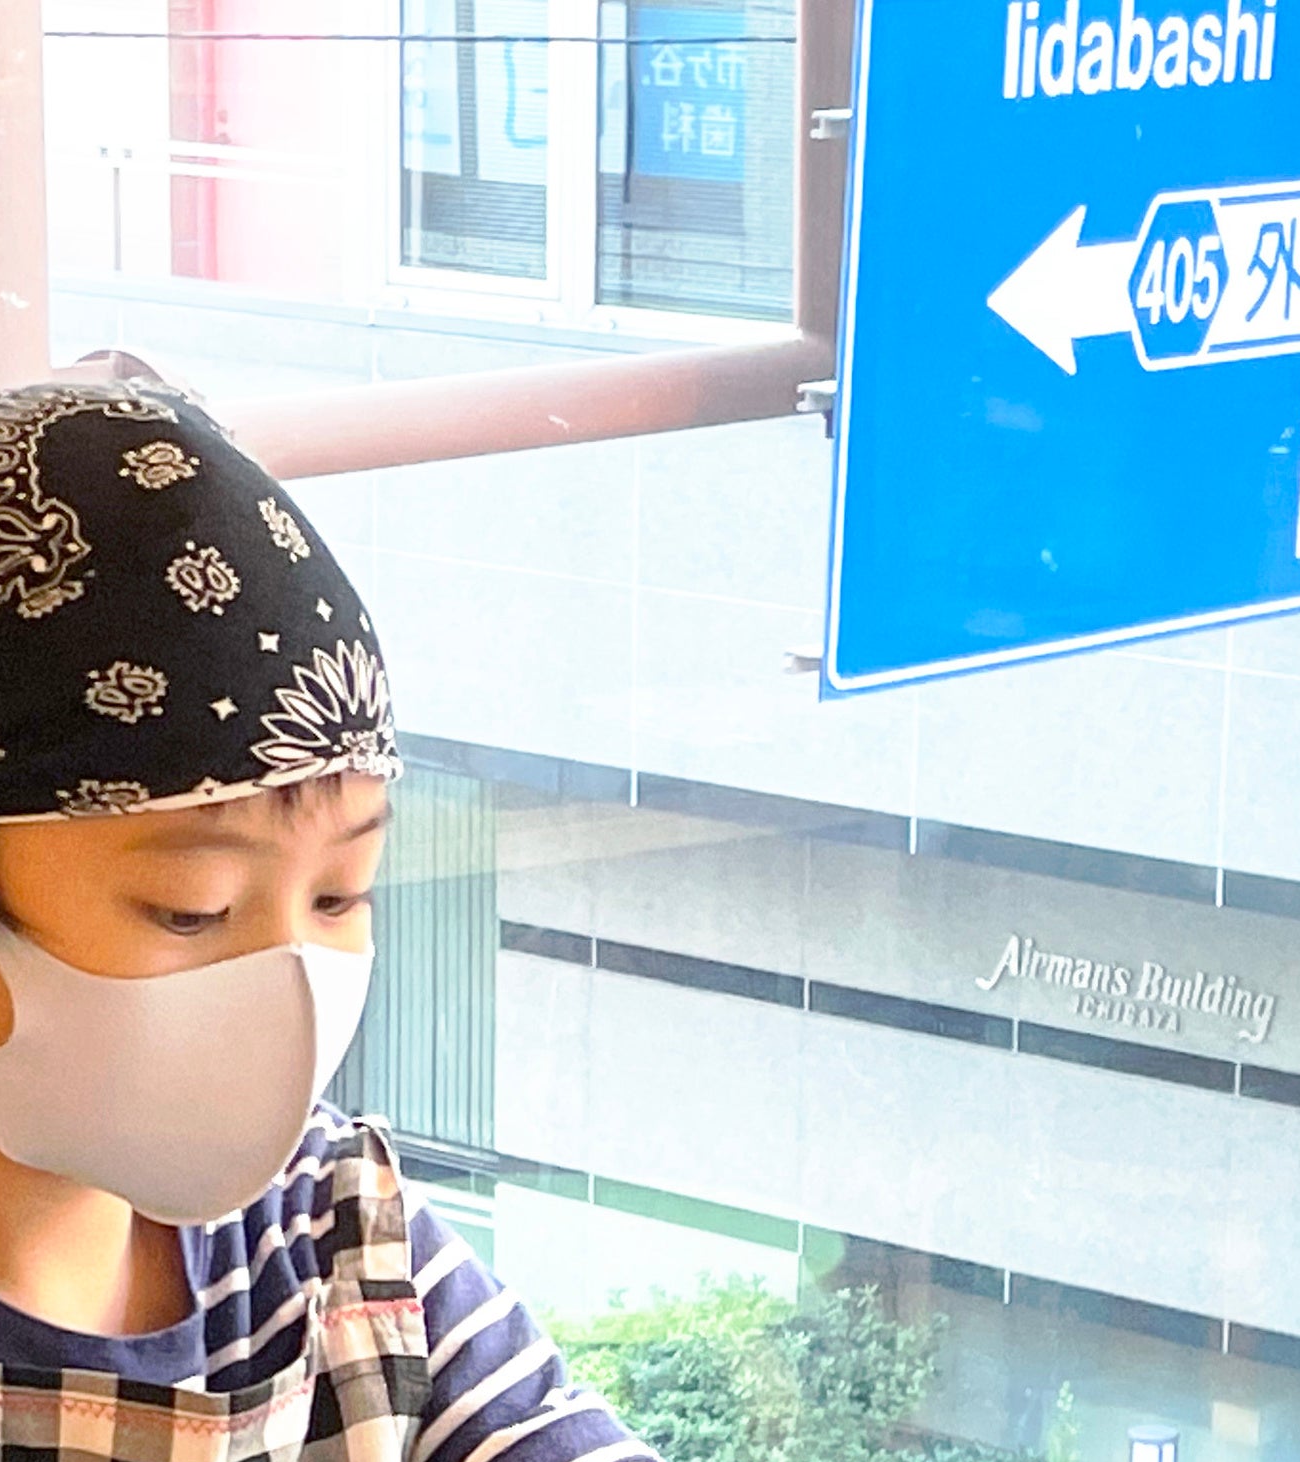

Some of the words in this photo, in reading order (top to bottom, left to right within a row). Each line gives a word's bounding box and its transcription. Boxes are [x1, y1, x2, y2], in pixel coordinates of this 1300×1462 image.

[1003, 0, 1277, 99] Iidabashi
[1137, 235, 1221, 325] 405
[1071, 995, 1181, 1033] ICHIGAYA
[1136, 960, 1275, 1043] Building
